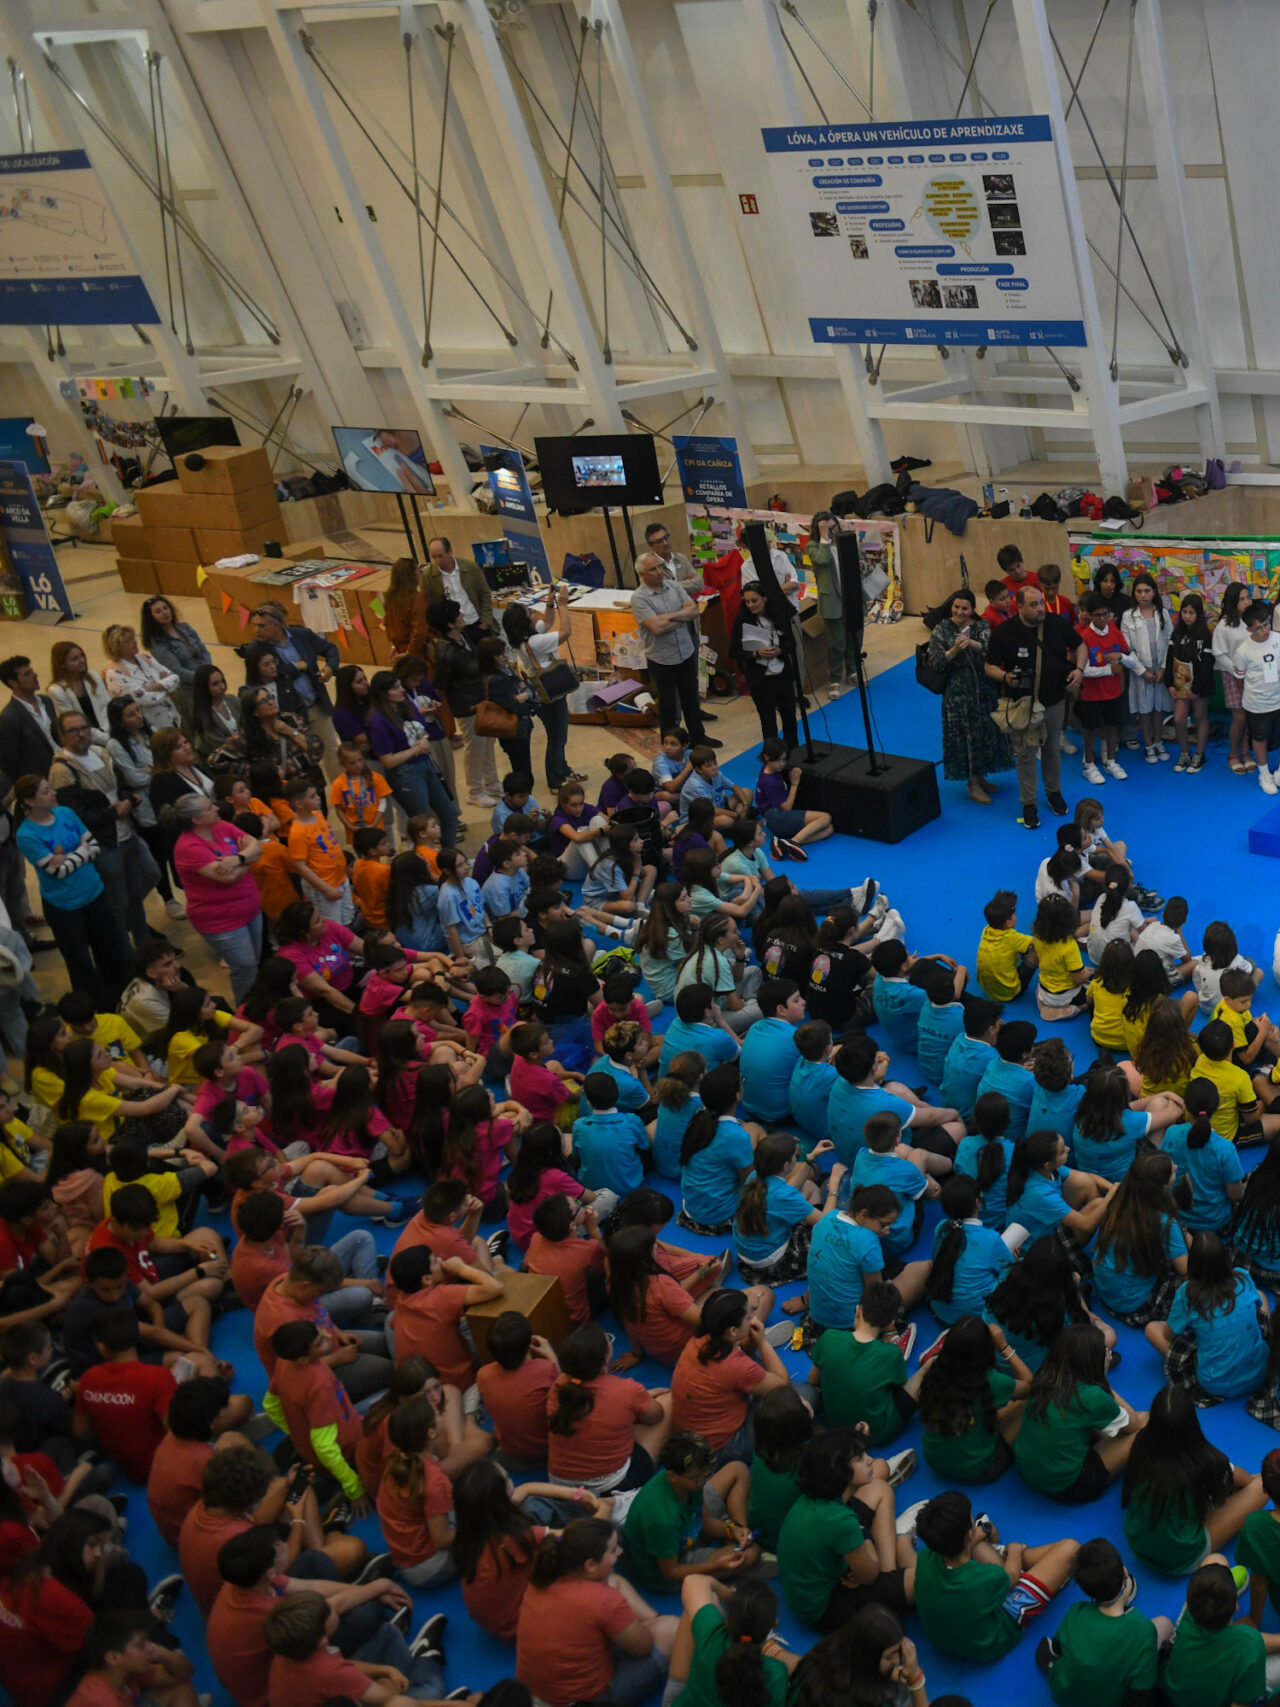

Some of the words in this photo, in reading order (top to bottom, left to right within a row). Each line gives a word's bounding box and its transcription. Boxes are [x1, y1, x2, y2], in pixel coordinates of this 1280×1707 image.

[787, 131, 817, 145] LÓVA,
[819, 134, 826, 143] A
[827, 130, 861, 143] ÓPERA
[863, 131, 878, 142] UN
[879, 126, 931, 140] VEHÍCULO
[934, 128, 948, 138] DE
[951, 124, 1024, 138] APRENDIZAXE
[29, 573, 52, 593] LÓ
[6, 606, 20, 616] VA
[34, 595, 61, 610] VA
